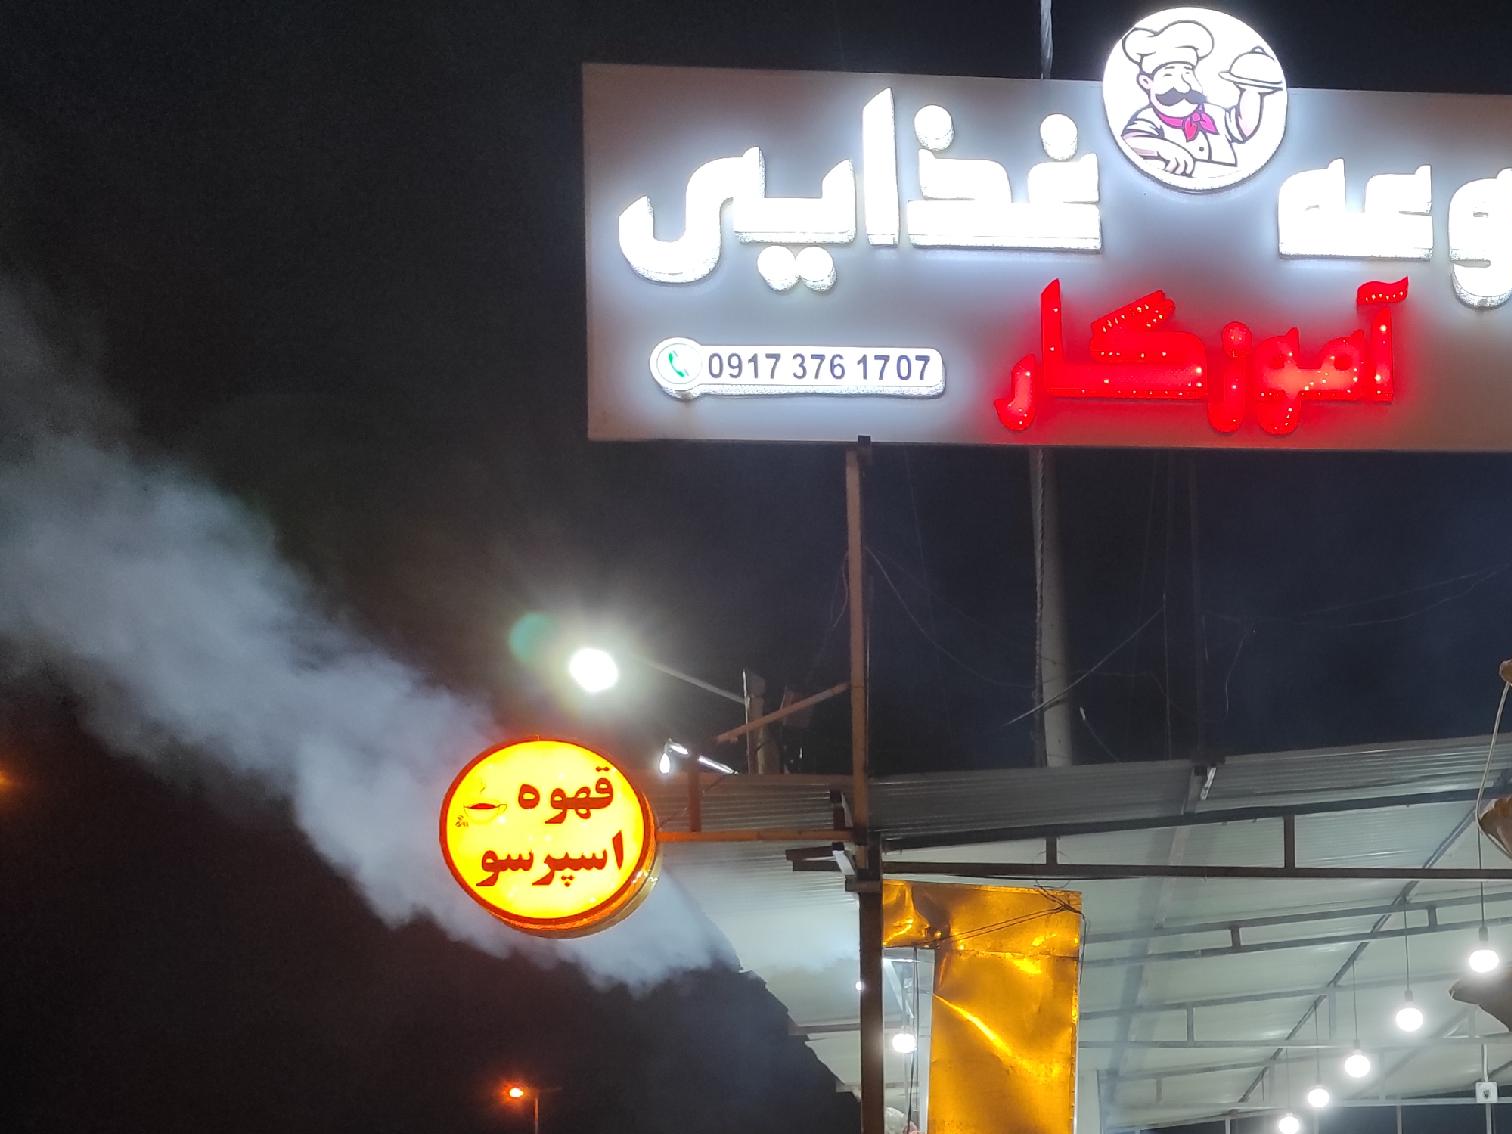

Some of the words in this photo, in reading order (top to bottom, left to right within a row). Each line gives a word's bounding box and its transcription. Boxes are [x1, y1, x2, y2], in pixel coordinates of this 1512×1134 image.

[618, 87, 1102, 292] غذایی
[708, 352, 781, 380] 0917
[792, 353, 846, 380] 376
[856, 353, 931, 381] 1707
[518, 766, 614, 824] قهوه
[475, 830, 624, 887] اسپرسو
